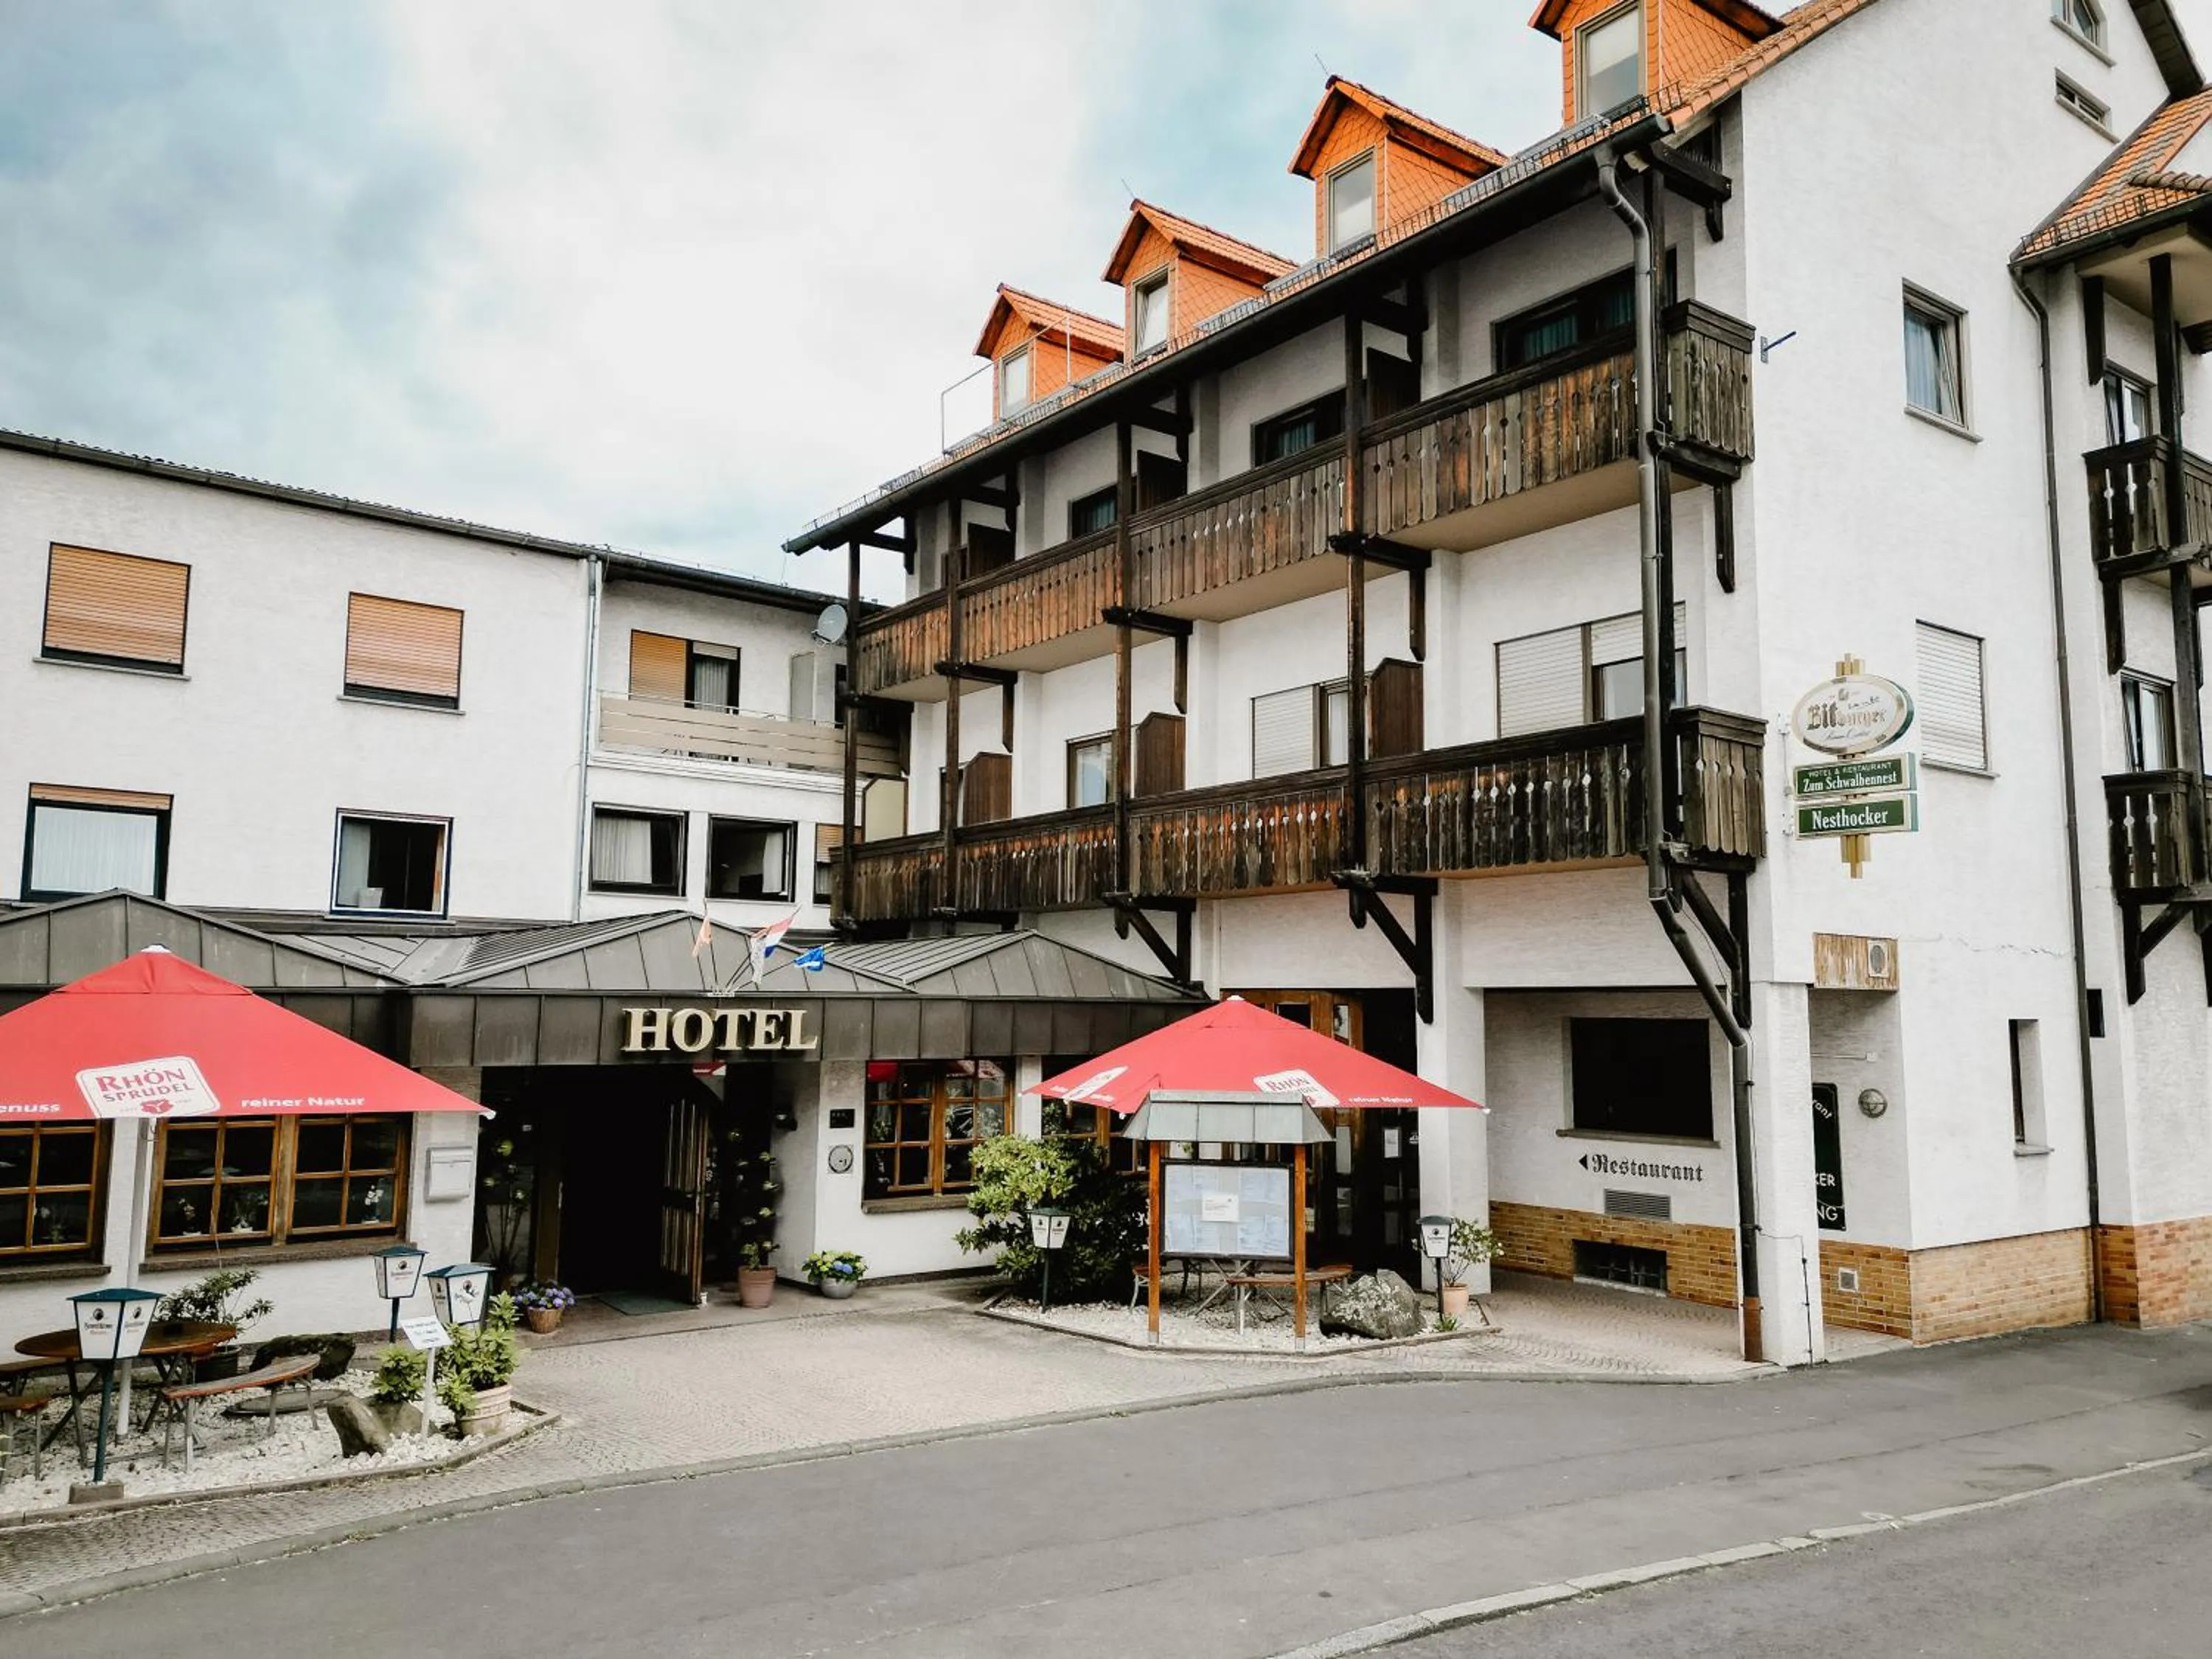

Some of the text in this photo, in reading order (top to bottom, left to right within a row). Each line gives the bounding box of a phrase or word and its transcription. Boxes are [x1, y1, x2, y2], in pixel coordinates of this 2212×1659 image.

[1809, 768, 1831, 778] HOTEL
[1843, 762, 1892, 773] RESTAURANT
[1803, 771, 1897, 792] Zum Schwalbennest
[1812, 806, 1888, 830] Nesthocker
[622, 1008, 818, 1052] HOTEL
[96, 1068, 186, 1092] RHÖN
[103, 1082, 195, 1102] SPRUDEL
[241, 1096, 365, 1107] reiner Natur
[0, 1103, 60, 1113] enuss
[1592, 1154, 1703, 1182] Restaurant
